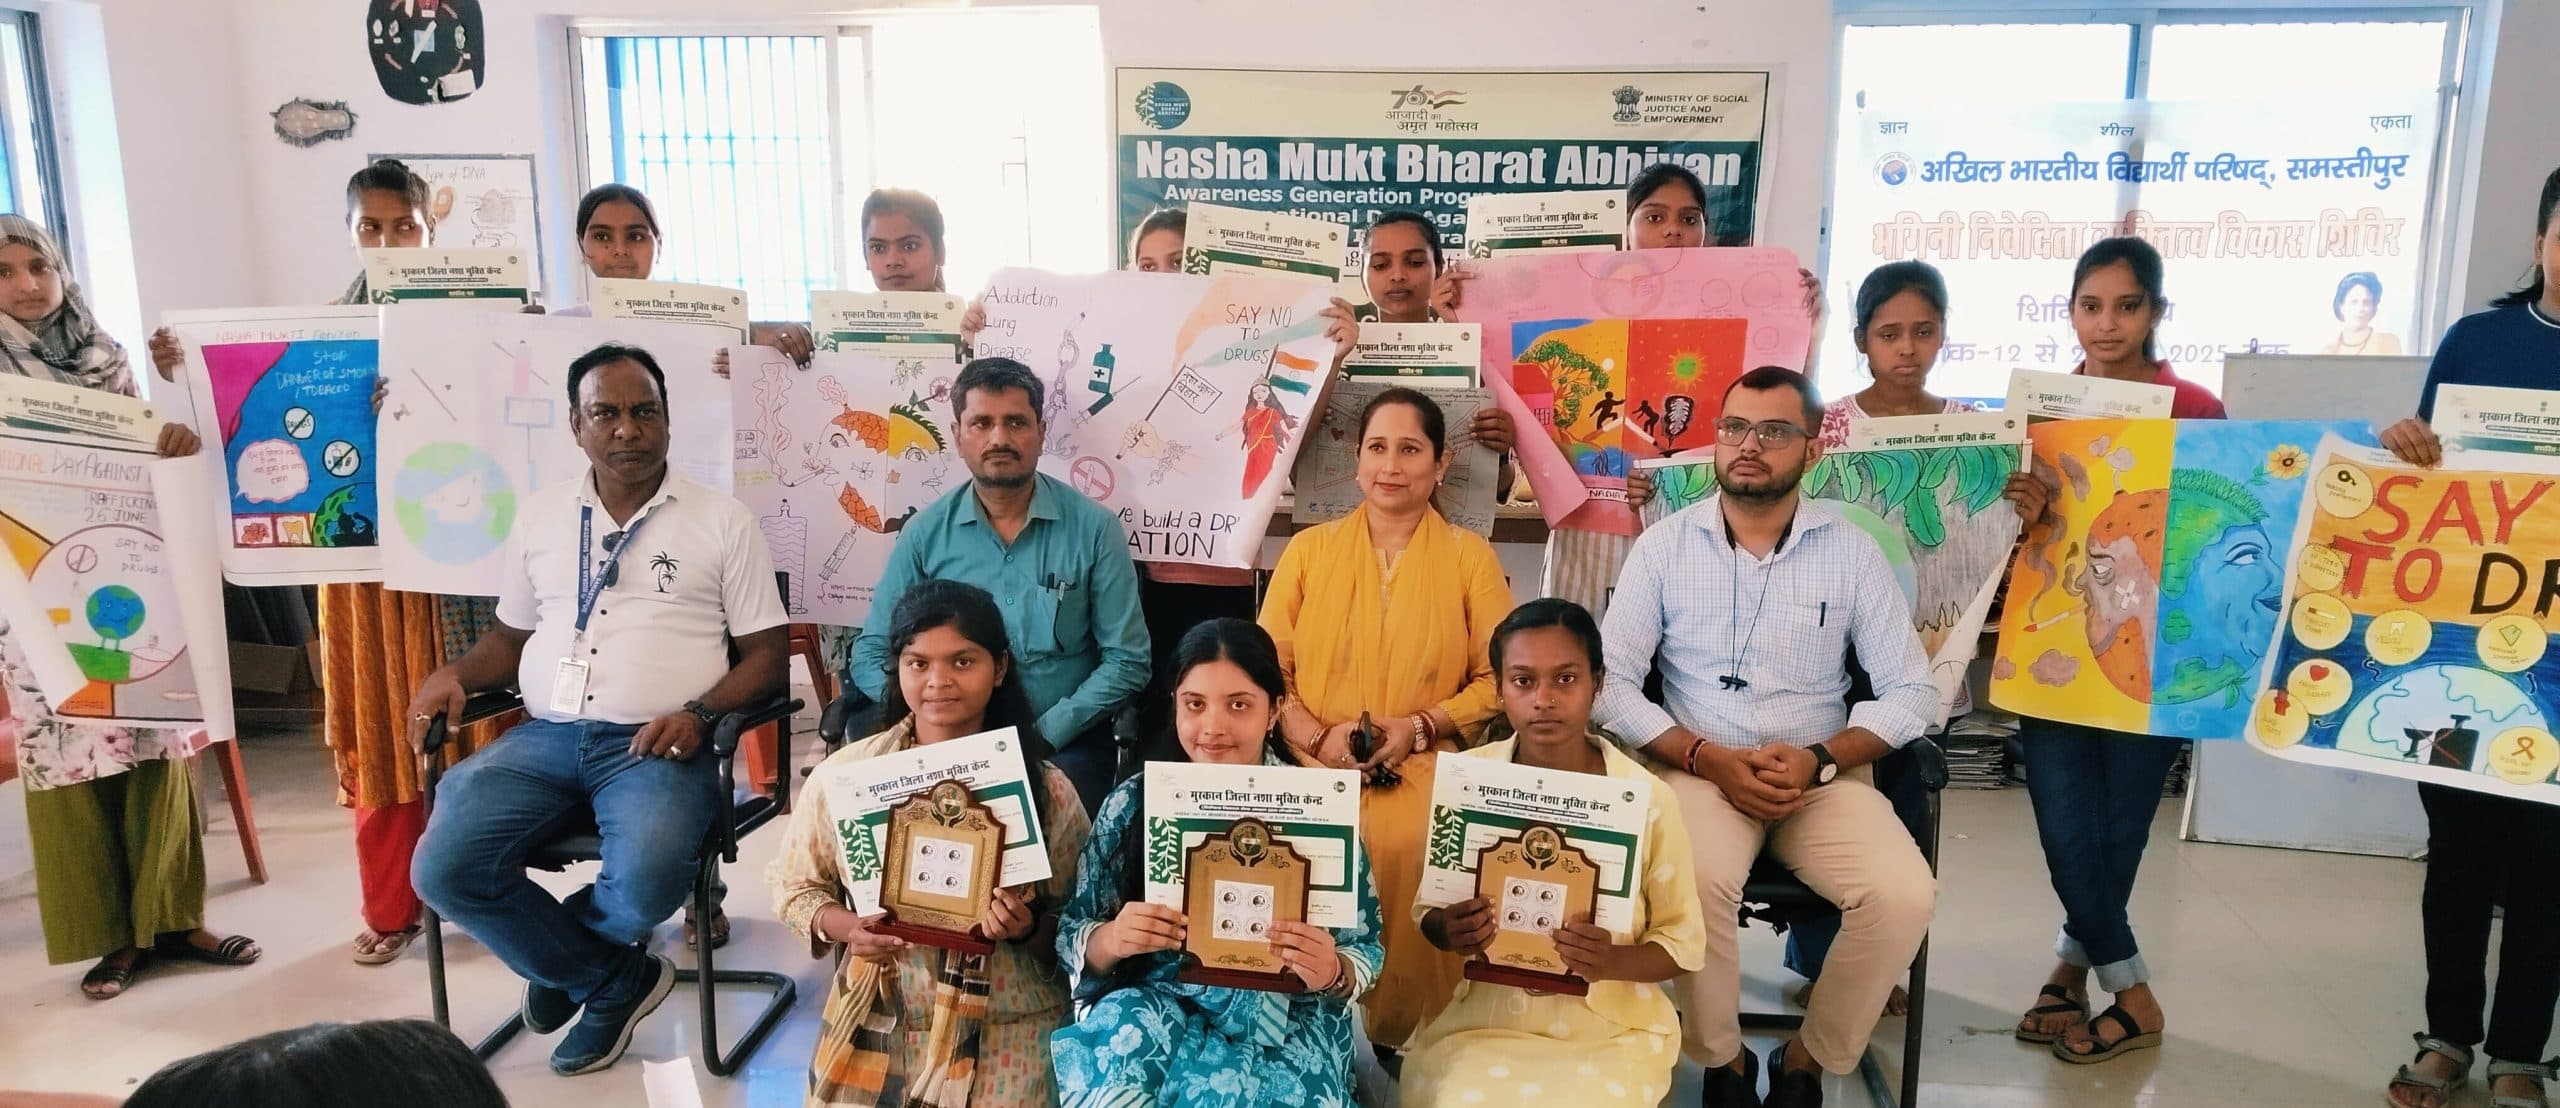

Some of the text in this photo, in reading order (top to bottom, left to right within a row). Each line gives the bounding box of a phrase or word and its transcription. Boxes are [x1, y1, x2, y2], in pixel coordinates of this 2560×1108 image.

[1645, 95, 1750, 103] MINISTRY OF SOCIAL
[1385, 108, 1441, 121] आजादी का
[1690, 105, 1712, 113] AND
[1396, 118, 1479, 134] अमृत महोत्सव
[1643, 116, 1726, 124] EMPOWERMENT
[1879, 120, 1909, 135] ज्ञान
[2368, 112, 2413, 132] एकता
[2100, 123, 2136, 137] शील
[1136, 141, 1741, 187] Nasha Mukt Bharat Abhian
[1921, 147, 2409, 190] अखिल भारतीय विद्यार्थी परिषद्, समस्तीपुर
[1164, 184, 1283, 202] Awareness
[1289, 187, 1414, 205] Generation
[1871, 211, 1964, 260] भगिनी
[1968, 211, 2088, 260] निवेदिता
[2215, 210, 2316, 259] विकास
[2317, 208, 2407, 258] शिविर
[983, 285, 1059, 308] Addiction
[1225, 303, 1295, 327] SAY NO
[983, 315, 1017, 338] Lung
[1241, 327, 1260, 341] TO
[979, 342, 1032, 362] Disease
[1224, 347, 1270, 365] DRUGS
[2034, 337, 2058, 363] से
[2170, 344, 2225, 363] 2025
[113, 509, 147, 524] JUNE
[2362, 474, 2556, 547] SAY
[1143, 509, 1183, 529] build
[1188, 511, 1202, 529] a
[1210, 513, 1240, 535] DR
[143, 543, 161, 553] NO
[1127, 530, 1215, 559] ATION
[129, 554, 142, 562] TO
[2327, 535, 2444, 603] TO
[899, 773, 925, 788] जिला
[926, 770, 945, 782] नशा
[1225, 789, 1251, 801] जिला
[1253, 792, 1273, 803] नशा
[1512, 788, 1538, 803] जिला
[1540, 794, 1559, 805] नशा
